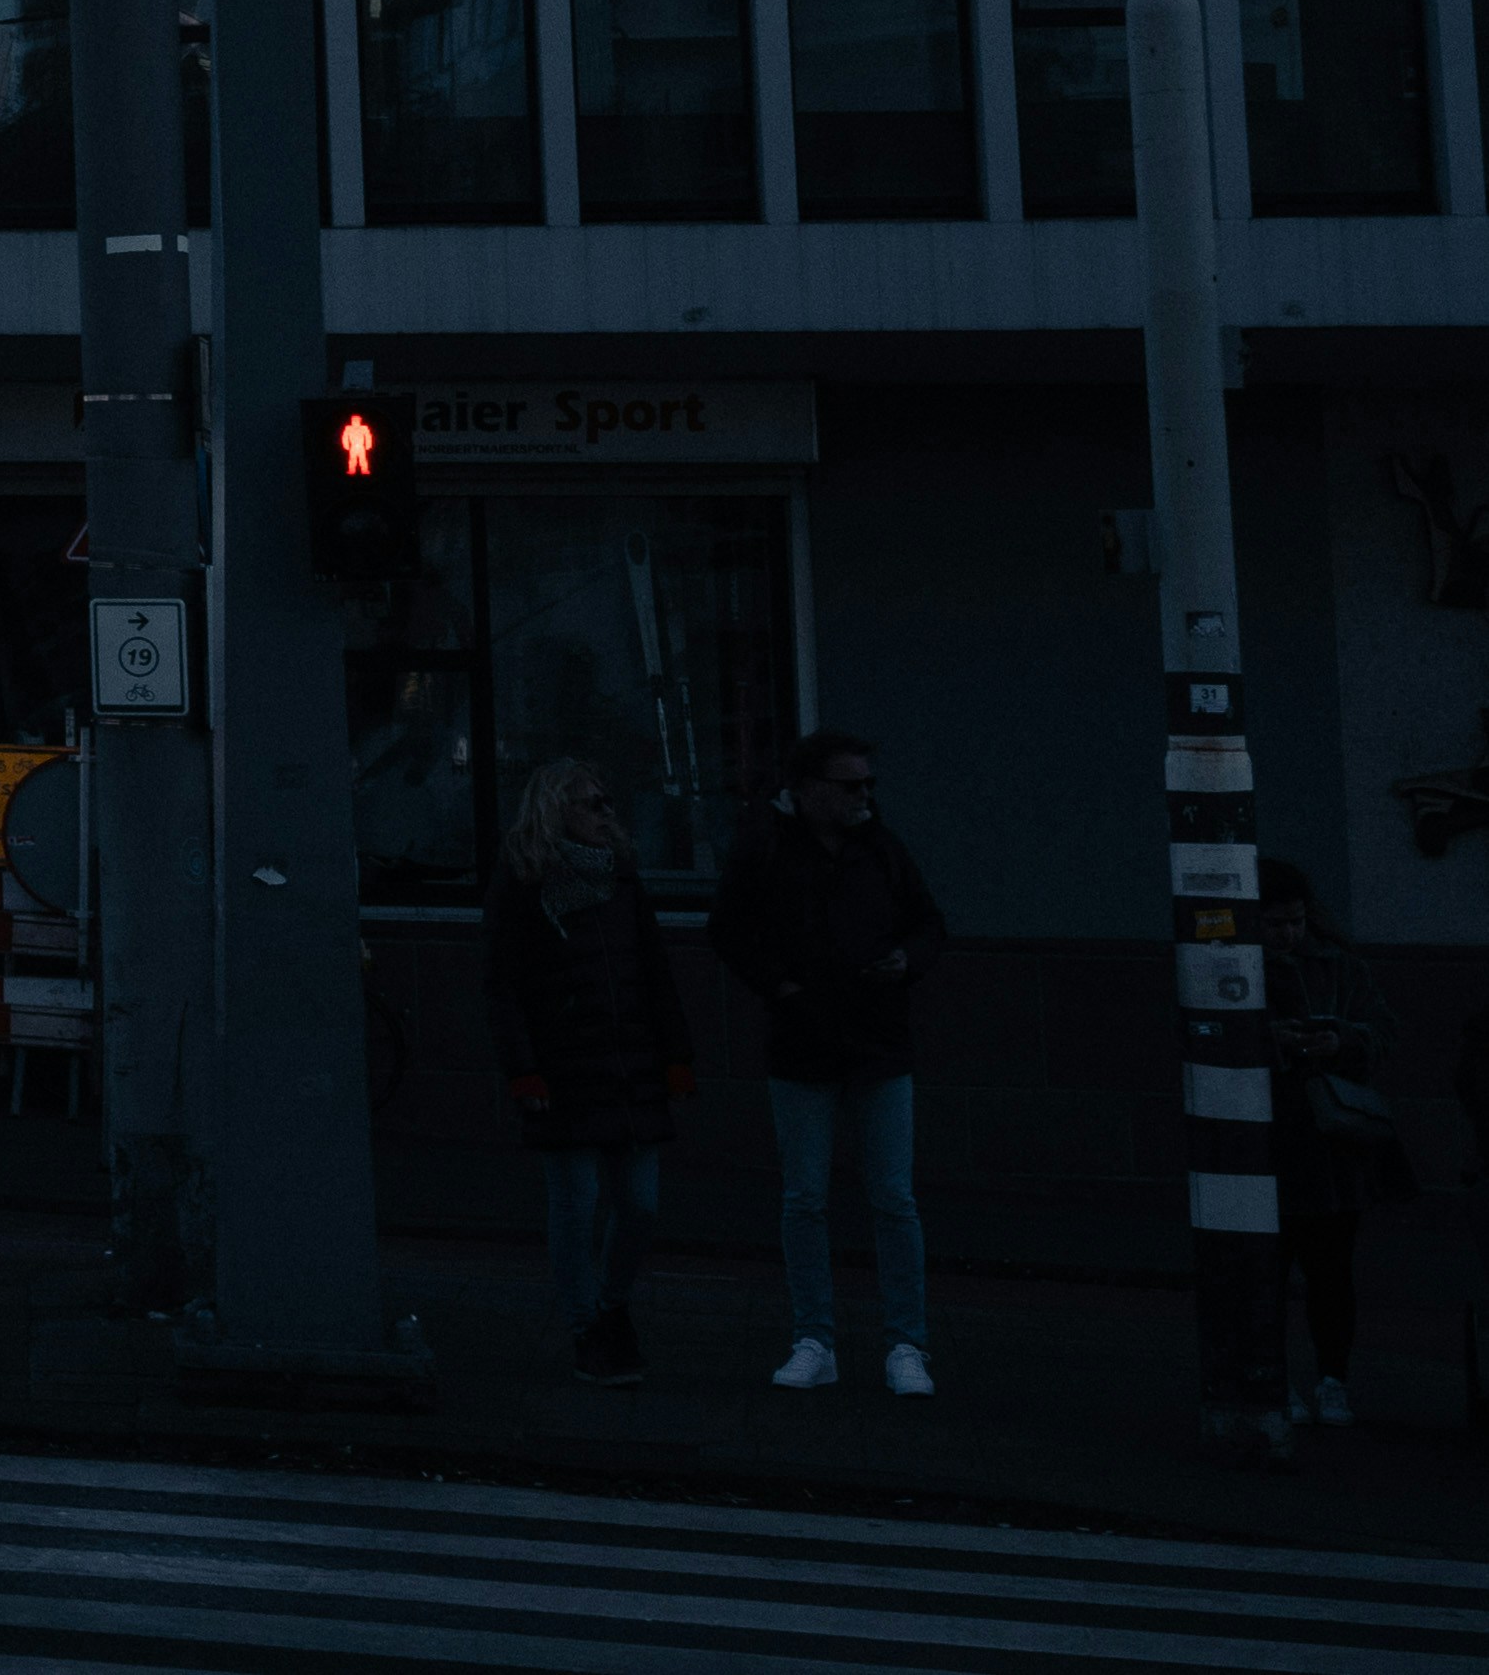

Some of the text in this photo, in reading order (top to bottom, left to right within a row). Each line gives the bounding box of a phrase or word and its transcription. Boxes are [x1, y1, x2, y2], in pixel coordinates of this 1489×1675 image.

[380, 389, 706, 444] aier Sport
[413, 443, 581, 455] .NORBERTMAIERSPORT.NL
[127, 648, 152, 666] 19
[1201, 688, 1217, 700] 31
